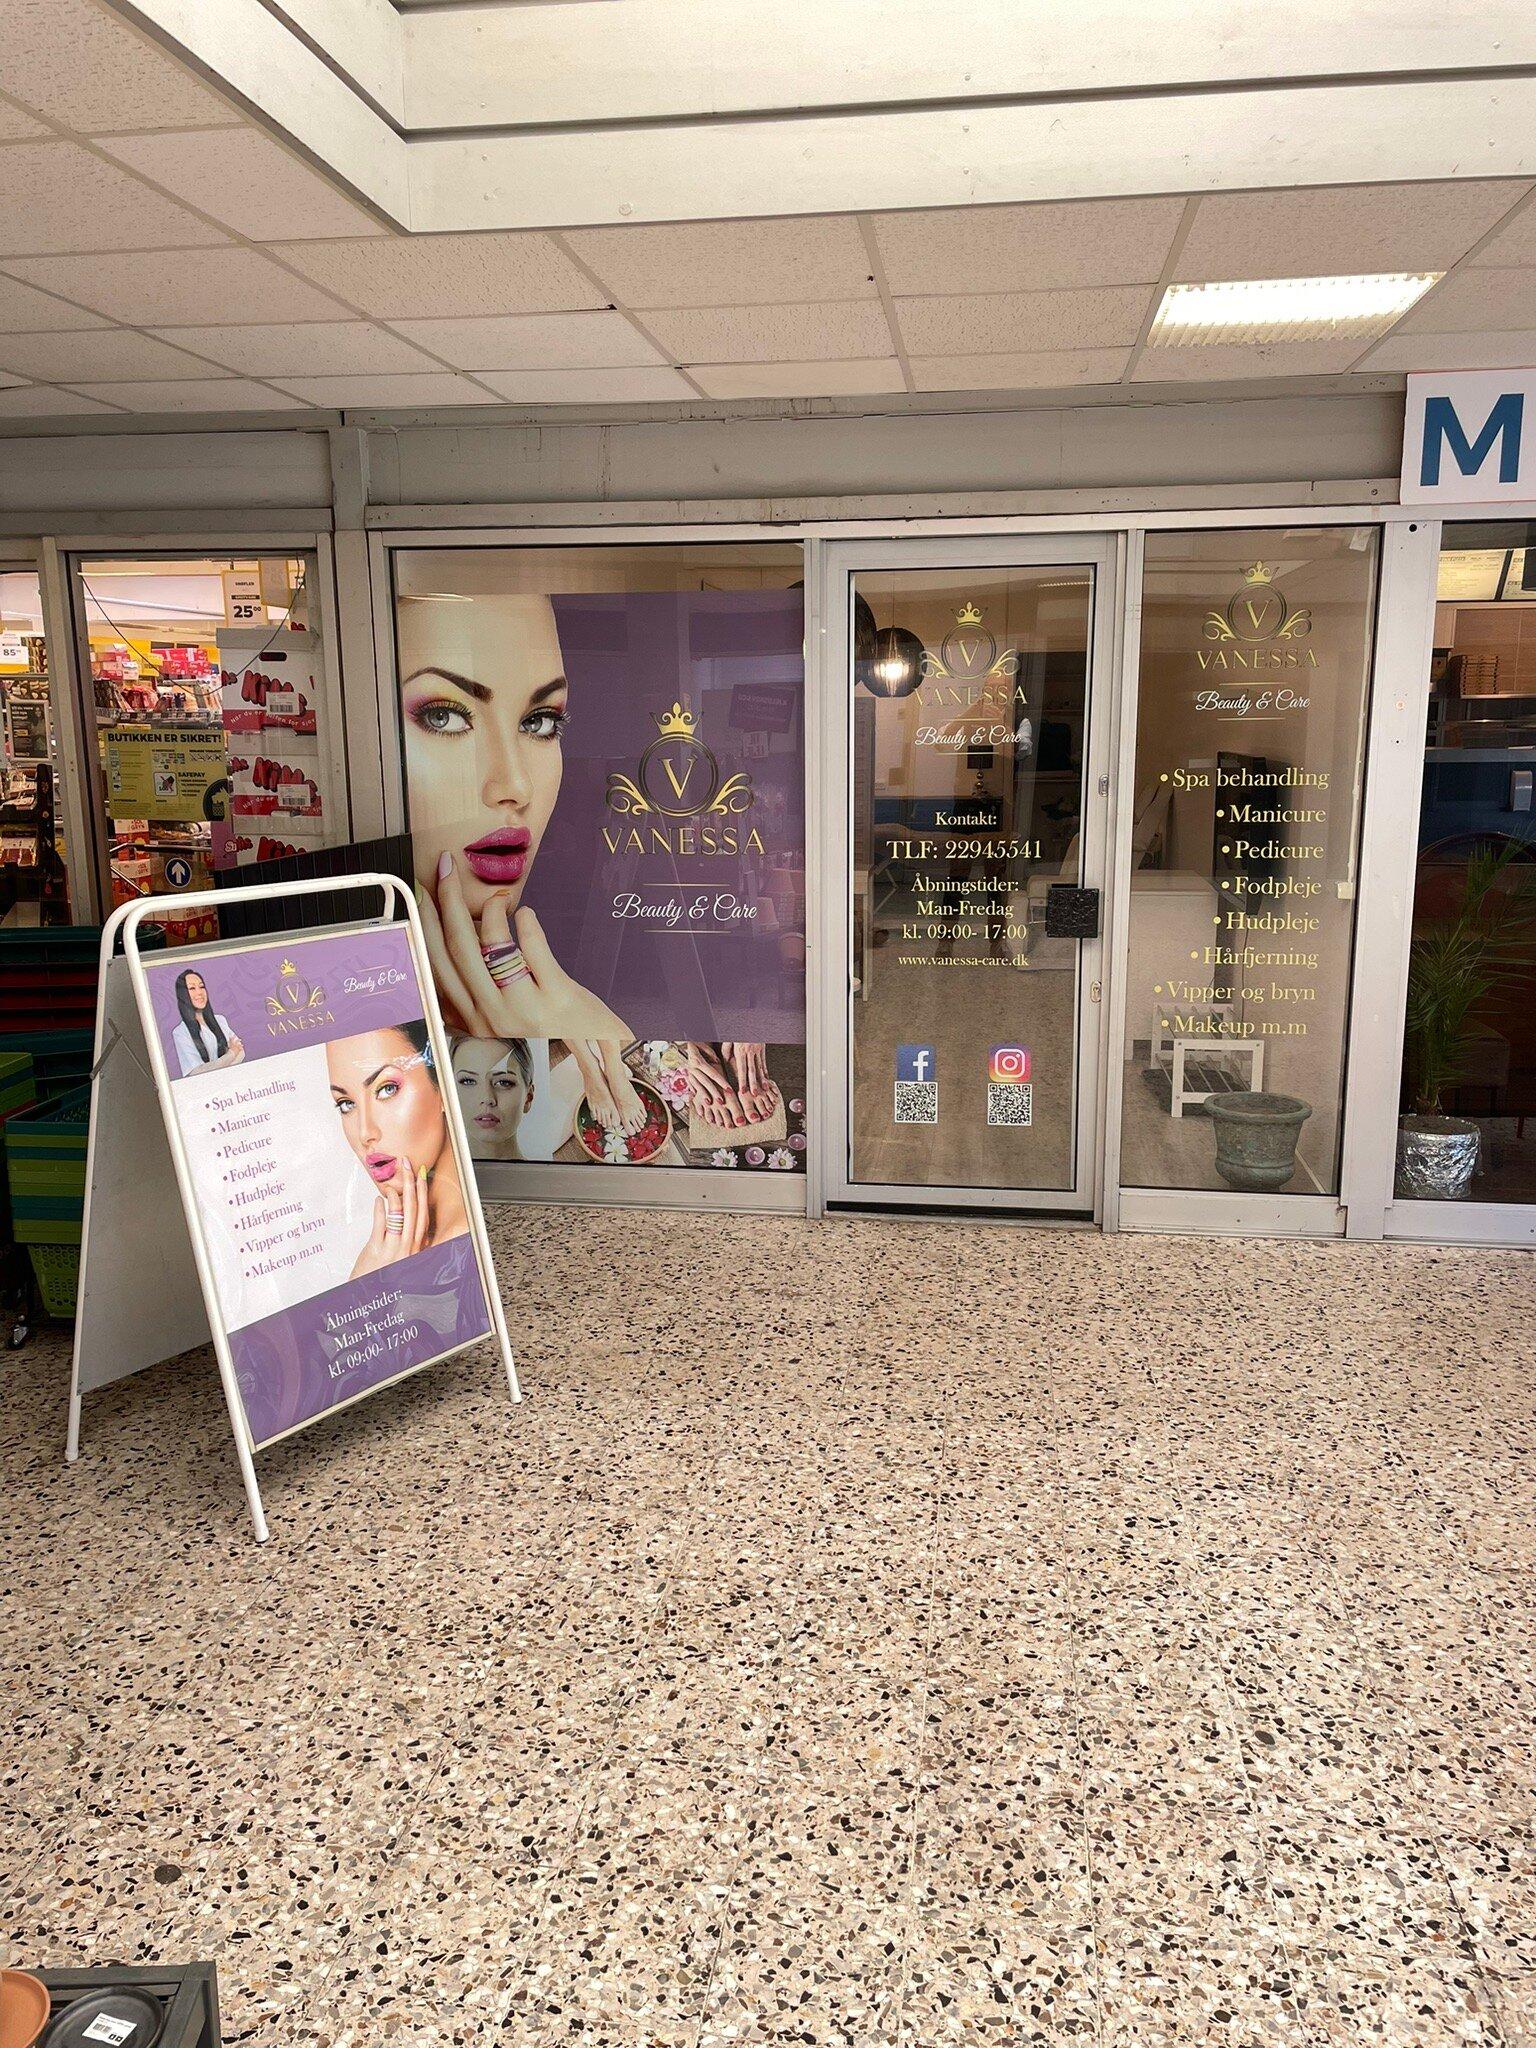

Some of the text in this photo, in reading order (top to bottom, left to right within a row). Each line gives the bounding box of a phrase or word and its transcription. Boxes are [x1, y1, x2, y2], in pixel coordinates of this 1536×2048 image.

[1420, 393, 1524, 486] M
[1197, 648, 1319, 670] VANESSA
[914, 685, 1028, 706] VANESSA
[1195, 689, 1310, 716] Beauty & Care
[107, 733, 221, 743] BUTIKKEN ER SIKRET!
[914, 725, 1021, 750] Beauty & Care
[1173, 767, 1330, 791] Spa behandling
[935, 812, 997, 826] Kontakt:
[1229, 804, 1326, 823] Manicure
[601, 828, 766, 855] VANESSA
[886, 840, 1042, 859] TLF: 22945541
[1235, 840, 1324, 859] Pedicure
[911, 873, 1019, 895] Åbningstider:
[1234, 876, 1322, 898] Fodpleje
[612, 893, 758, 926] Beauty & Care
[916, 900, 1014, 917] Man-Fredag
[902, 924, 1027, 940] kl. 09:00- 17:00
[1226, 911, 1320, 934] Hudpleje
[898, 954, 1029, 966] www.vanessa-care.dk
[1203, 946, 1319, 969] Hårfjerning
[343, 976, 376, 993] Beauty
[377, 972, 387, 986] &
[1166, 981, 1316, 1003] Vipper og bryn
[267, 1010, 335, 1037] VANESSA
[1174, 1015, 1307, 1037] Makeup m.m
[211, 1080, 296, 1111] Spa behandling
[218, 1111, 271, 1134] Manicure
[223, 1136, 272, 1159] Pedicure
[229, 1158, 277, 1182] Fodpleje
[235, 1180, 285, 1206] Hudpleje
[240, 1202, 304, 1230] Hårfjerning
[245, 1217, 325, 1253] Vipper og bryn
[252, 1243, 324, 1278] Makeup m.m
[326, 1289, 403, 1332] Åbningstider:
[334, 1311, 405, 1352] Man-Fredag
[328, 1361, 345, 1378] kl.
[386, 1325, 418, 1351] 17:00
